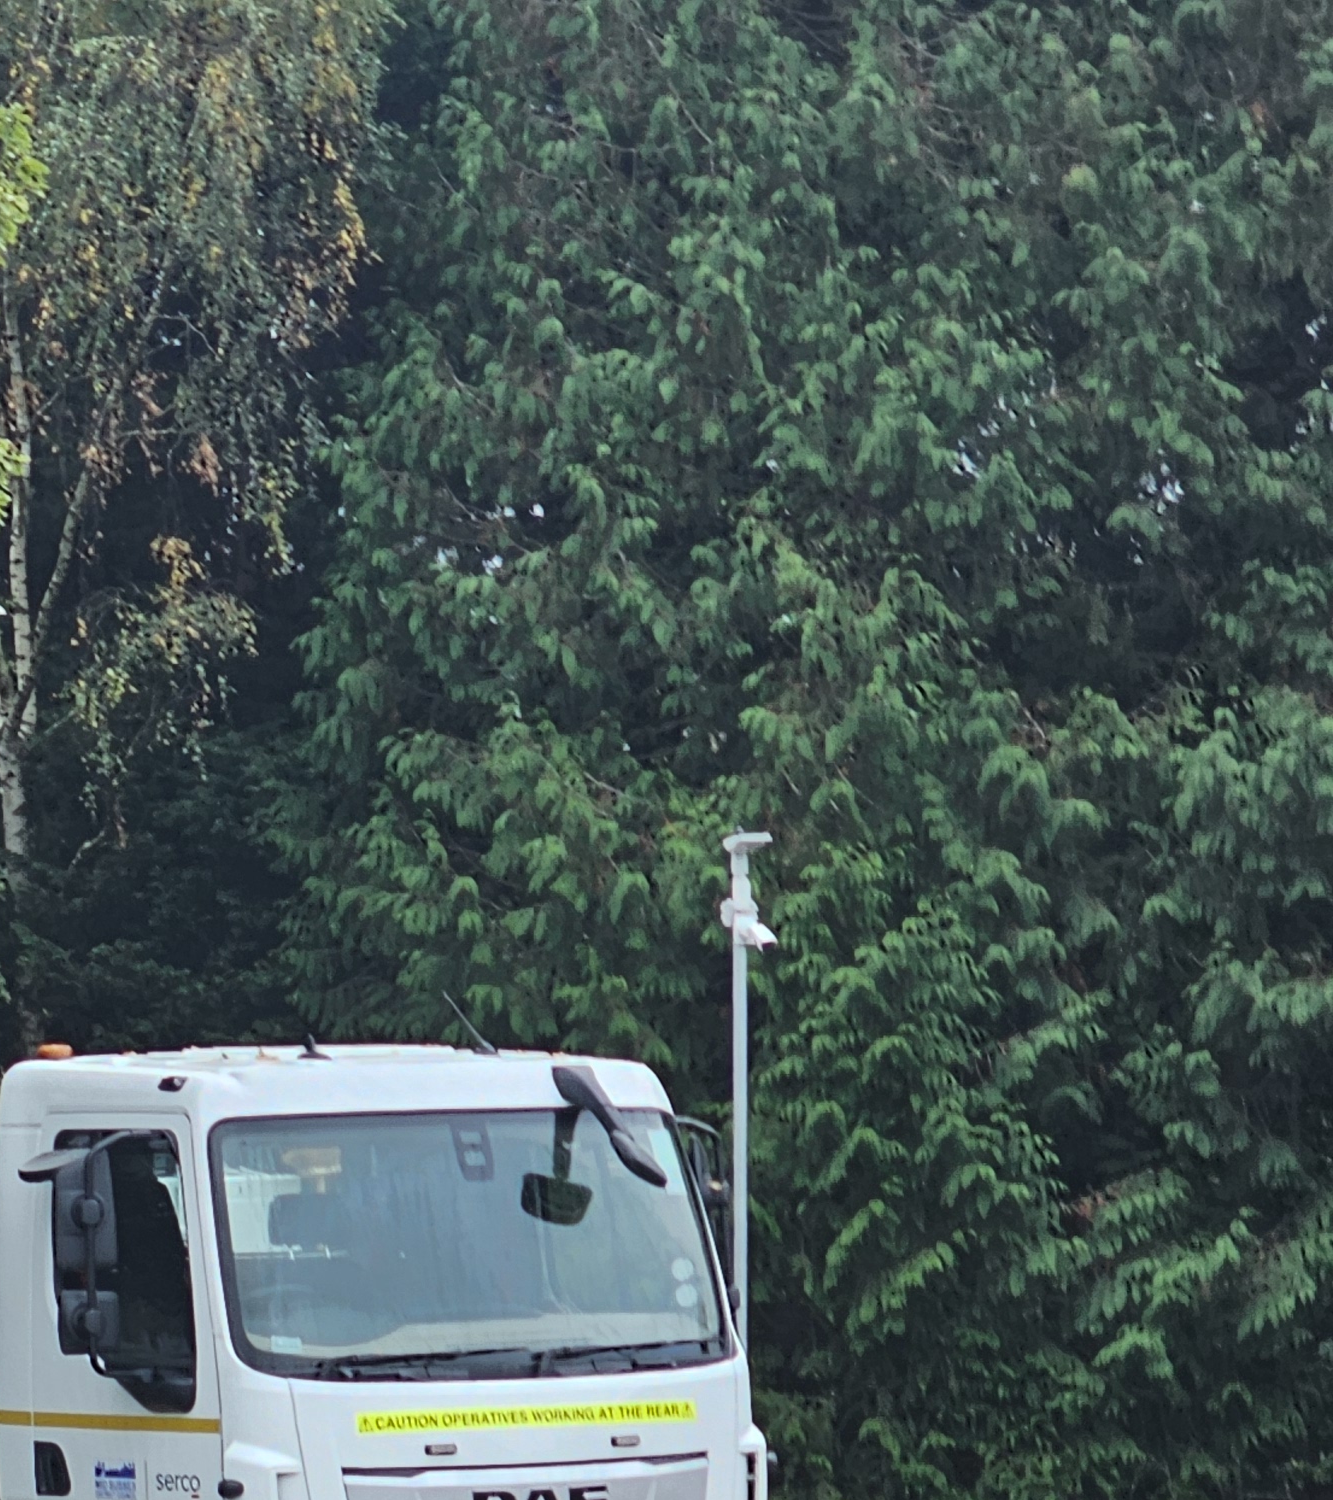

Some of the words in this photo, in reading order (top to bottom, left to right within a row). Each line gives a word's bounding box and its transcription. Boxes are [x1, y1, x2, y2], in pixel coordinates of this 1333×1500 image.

[375, 1414, 438, 1431] CAUTION
[442, 1409, 528, 1428] OPERATIVES
[532, 1407, 595, 1422] WORKING
[599, 1406, 615, 1420] AT
[618, 1405, 642, 1419] THE
[646, 1403, 680, 1417] REAR
[156, 1473, 201, 1492] serco
